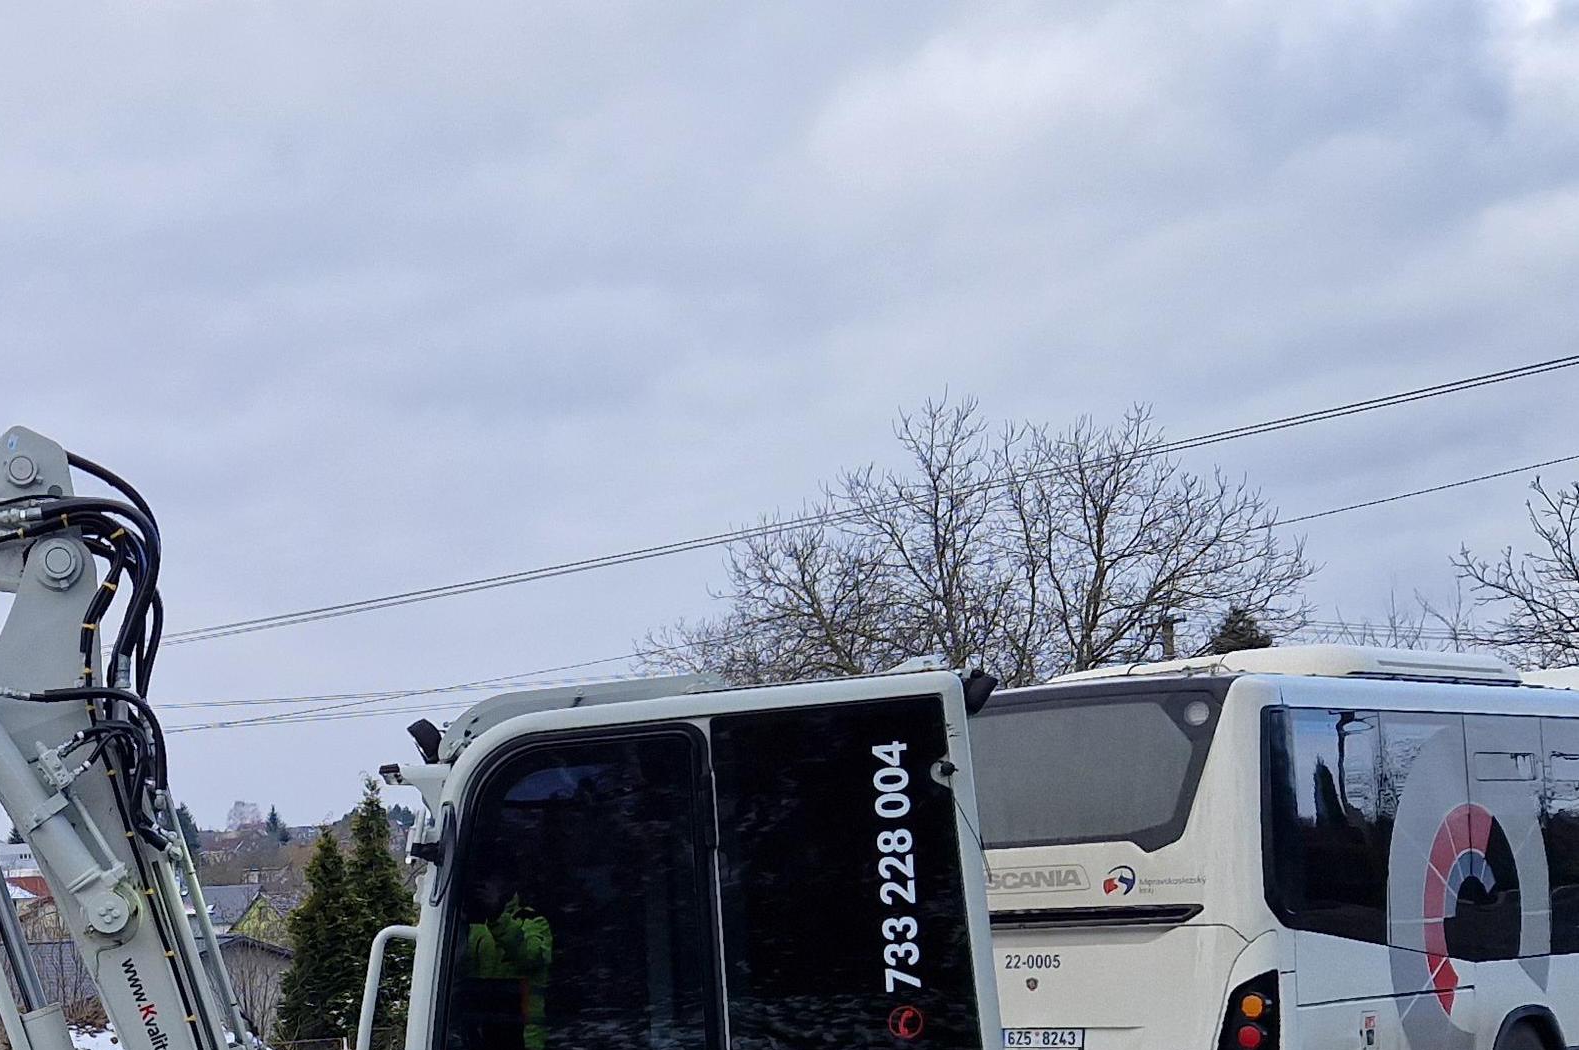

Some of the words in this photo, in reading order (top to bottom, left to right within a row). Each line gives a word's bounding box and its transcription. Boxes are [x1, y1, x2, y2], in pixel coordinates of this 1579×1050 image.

[871, 740, 910, 819] 004
[876, 828, 916, 905] 228
[985, 869, 1082, 891] SCANIA
[882, 916, 922, 993] 733
[1004, 954, 1061, 970] 22-0005
[1007, 1031, 1032, 1046] 6Z5
[1042, 1031, 1076, 1046] 8243
